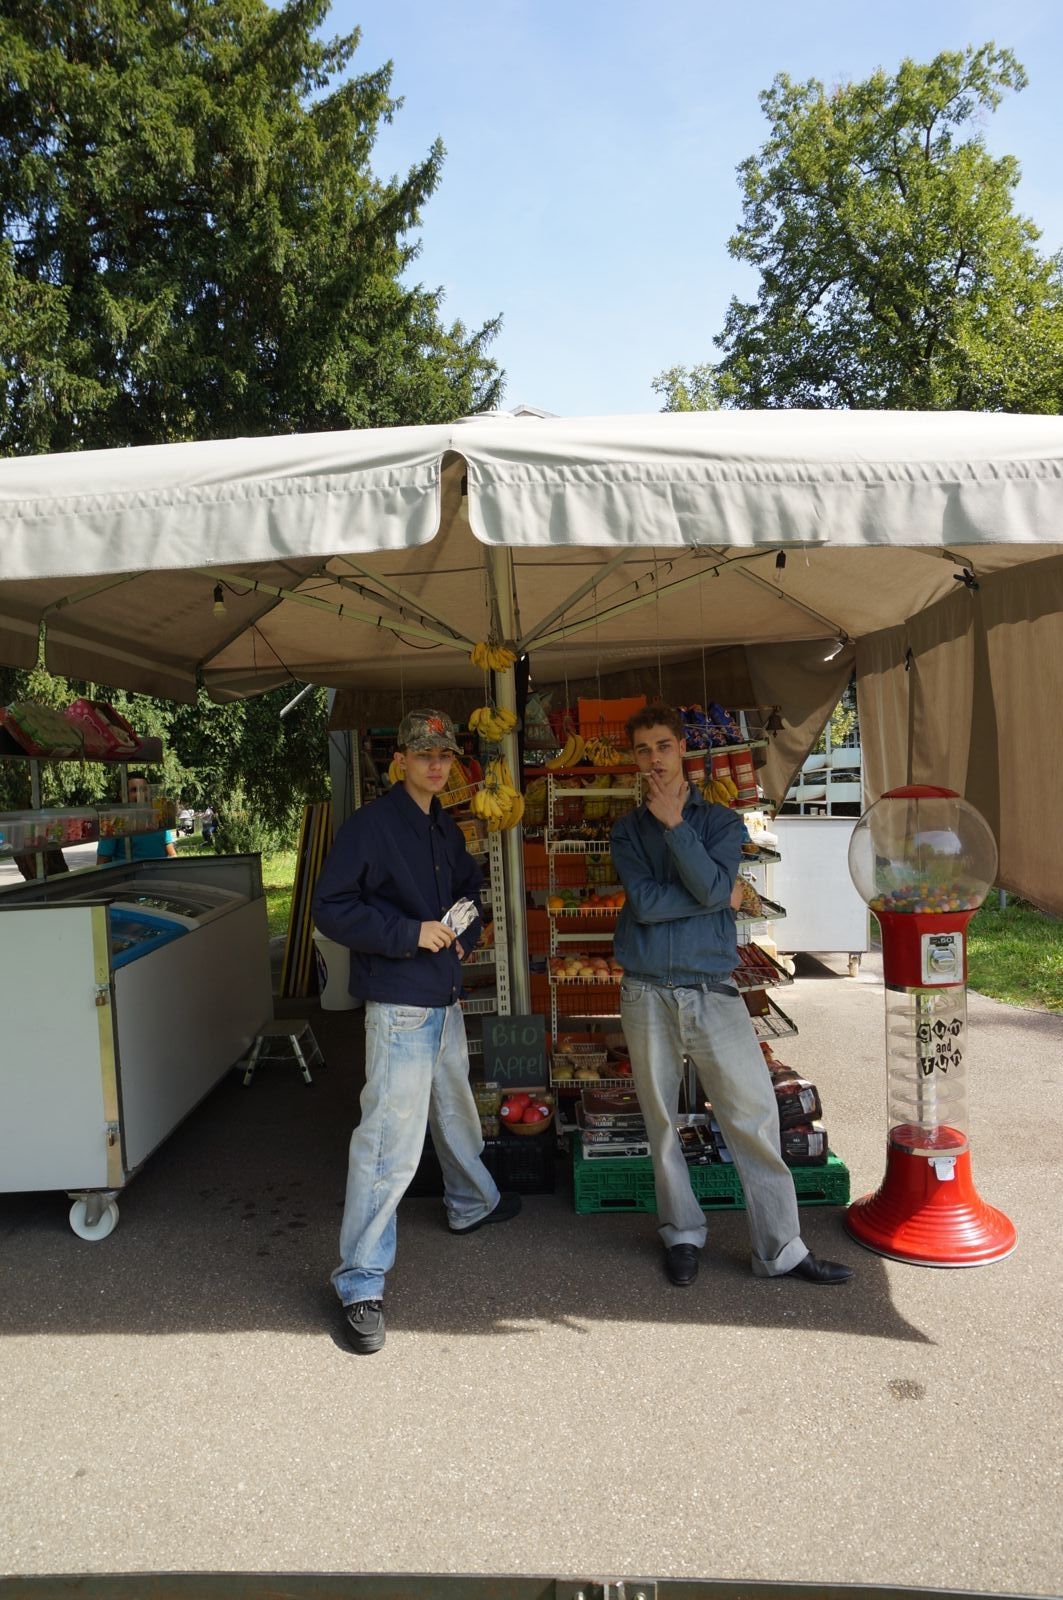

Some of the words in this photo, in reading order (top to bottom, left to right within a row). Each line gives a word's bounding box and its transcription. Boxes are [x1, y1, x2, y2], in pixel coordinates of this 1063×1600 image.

[917, 1018, 963, 1043] gum
[936, 1038, 952, 1053] and
[920, 1049, 962, 1076] fun
